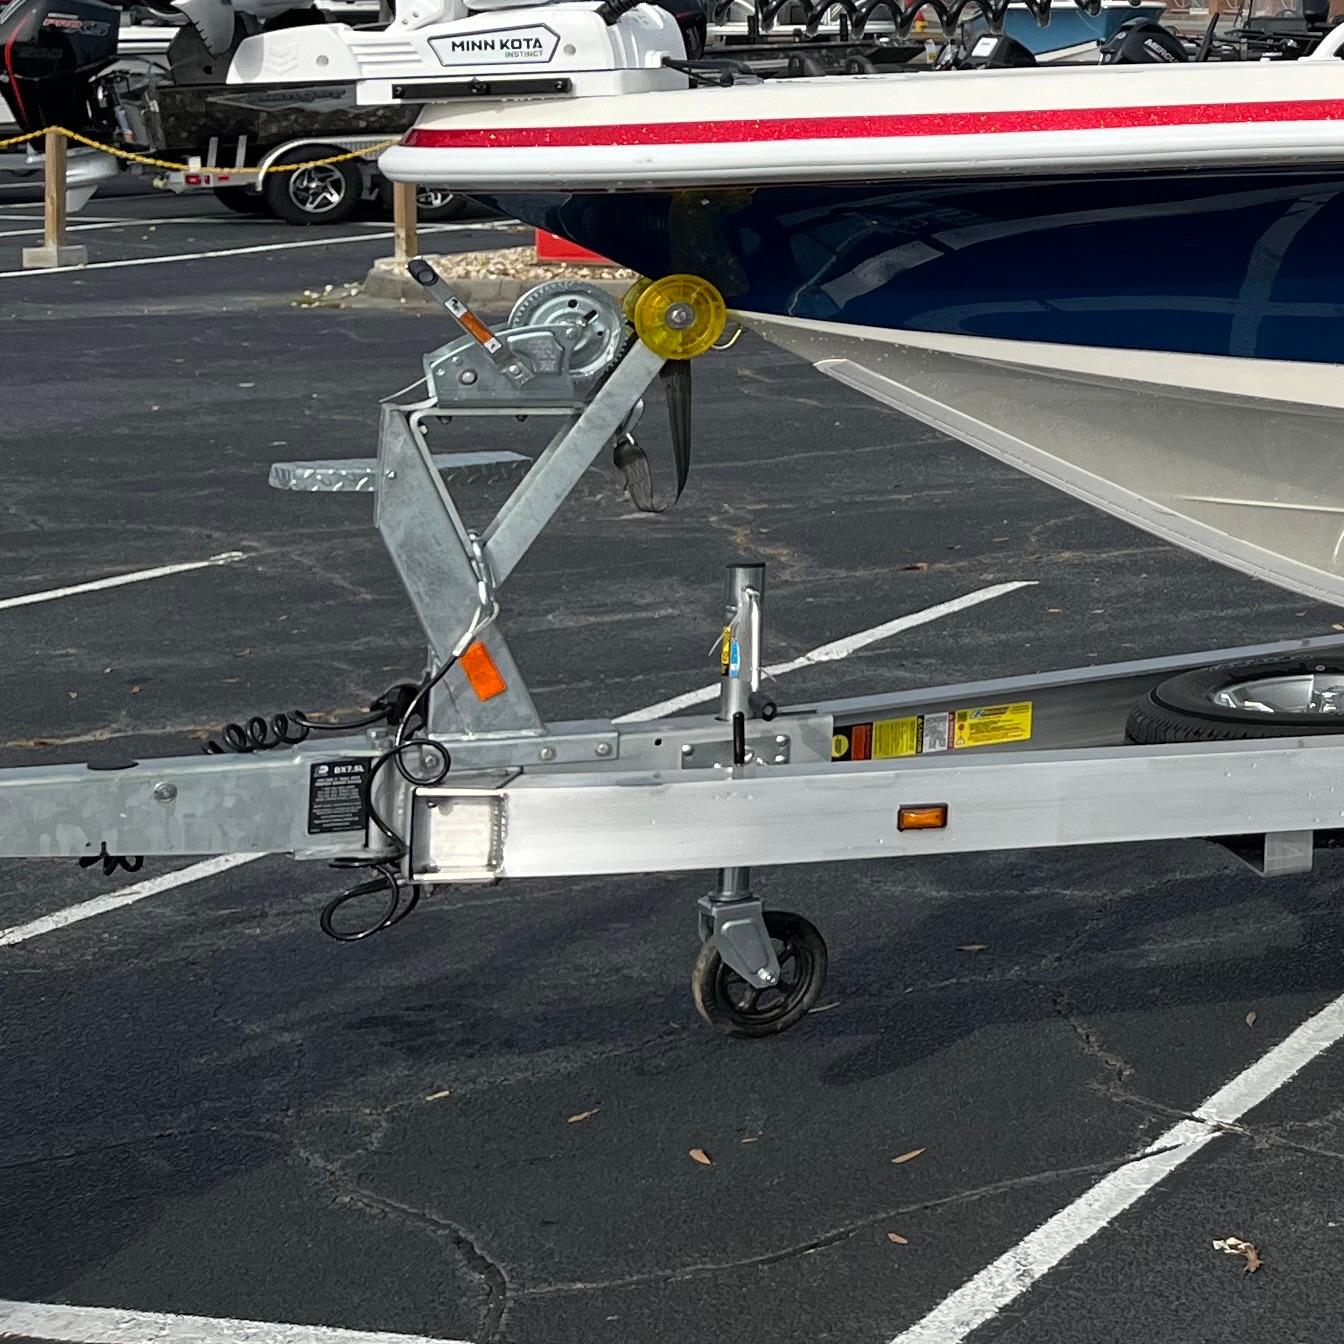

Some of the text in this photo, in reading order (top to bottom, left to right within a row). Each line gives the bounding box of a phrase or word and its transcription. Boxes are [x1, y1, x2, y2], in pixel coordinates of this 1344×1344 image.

[451, 37, 543, 52] MINN KOTA
[504, 50, 544, 59] INSTINCT
